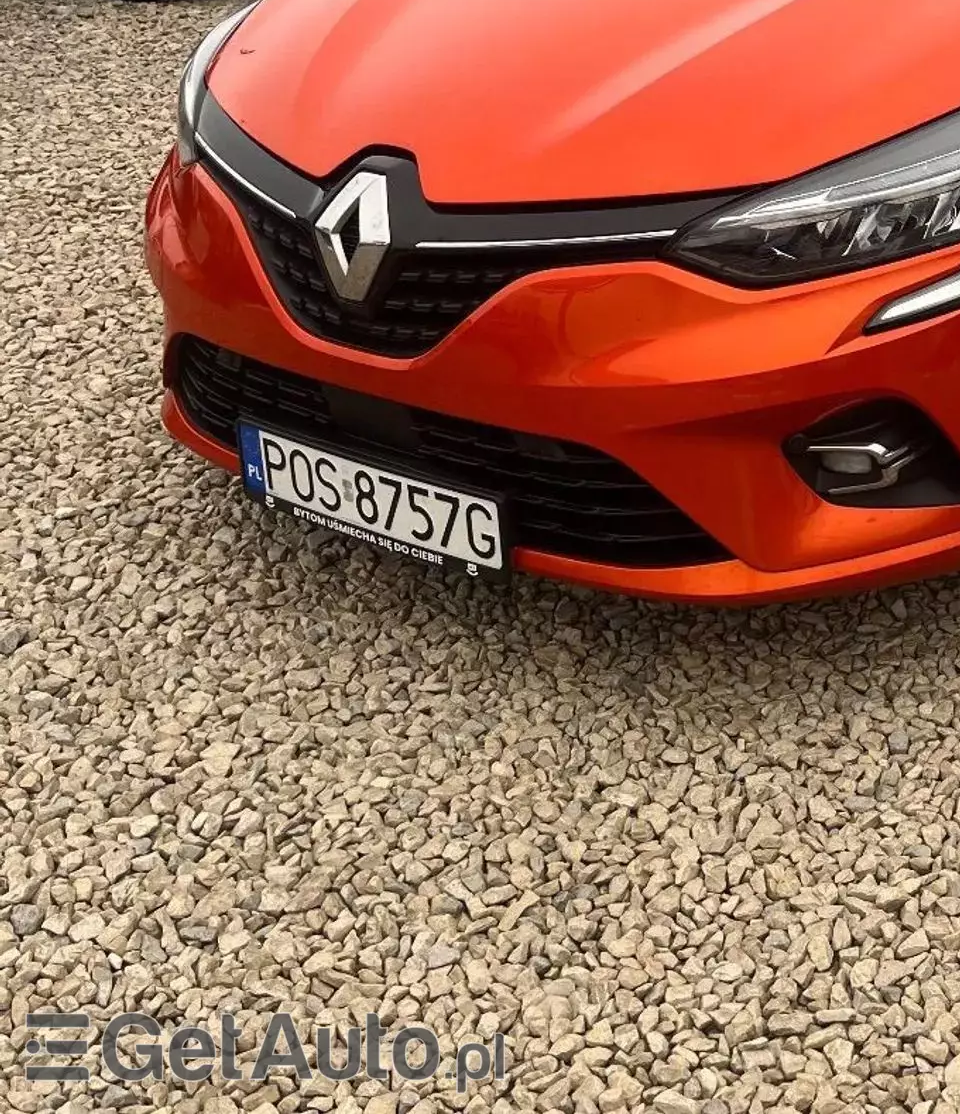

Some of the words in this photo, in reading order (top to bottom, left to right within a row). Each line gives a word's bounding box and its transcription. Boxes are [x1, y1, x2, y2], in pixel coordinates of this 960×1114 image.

[248, 463, 263, 482] PL
[263, 437, 342, 512] POS
[354, 470, 496, 559] 8757G
[293, 507, 326, 526] BYTOM
[327, 519, 377, 545] UŚMIECHA
[377, 536, 393, 552] SIĘ
[394, 543, 410, 555] DO
[411, 547, 444, 565] CIEBIE
